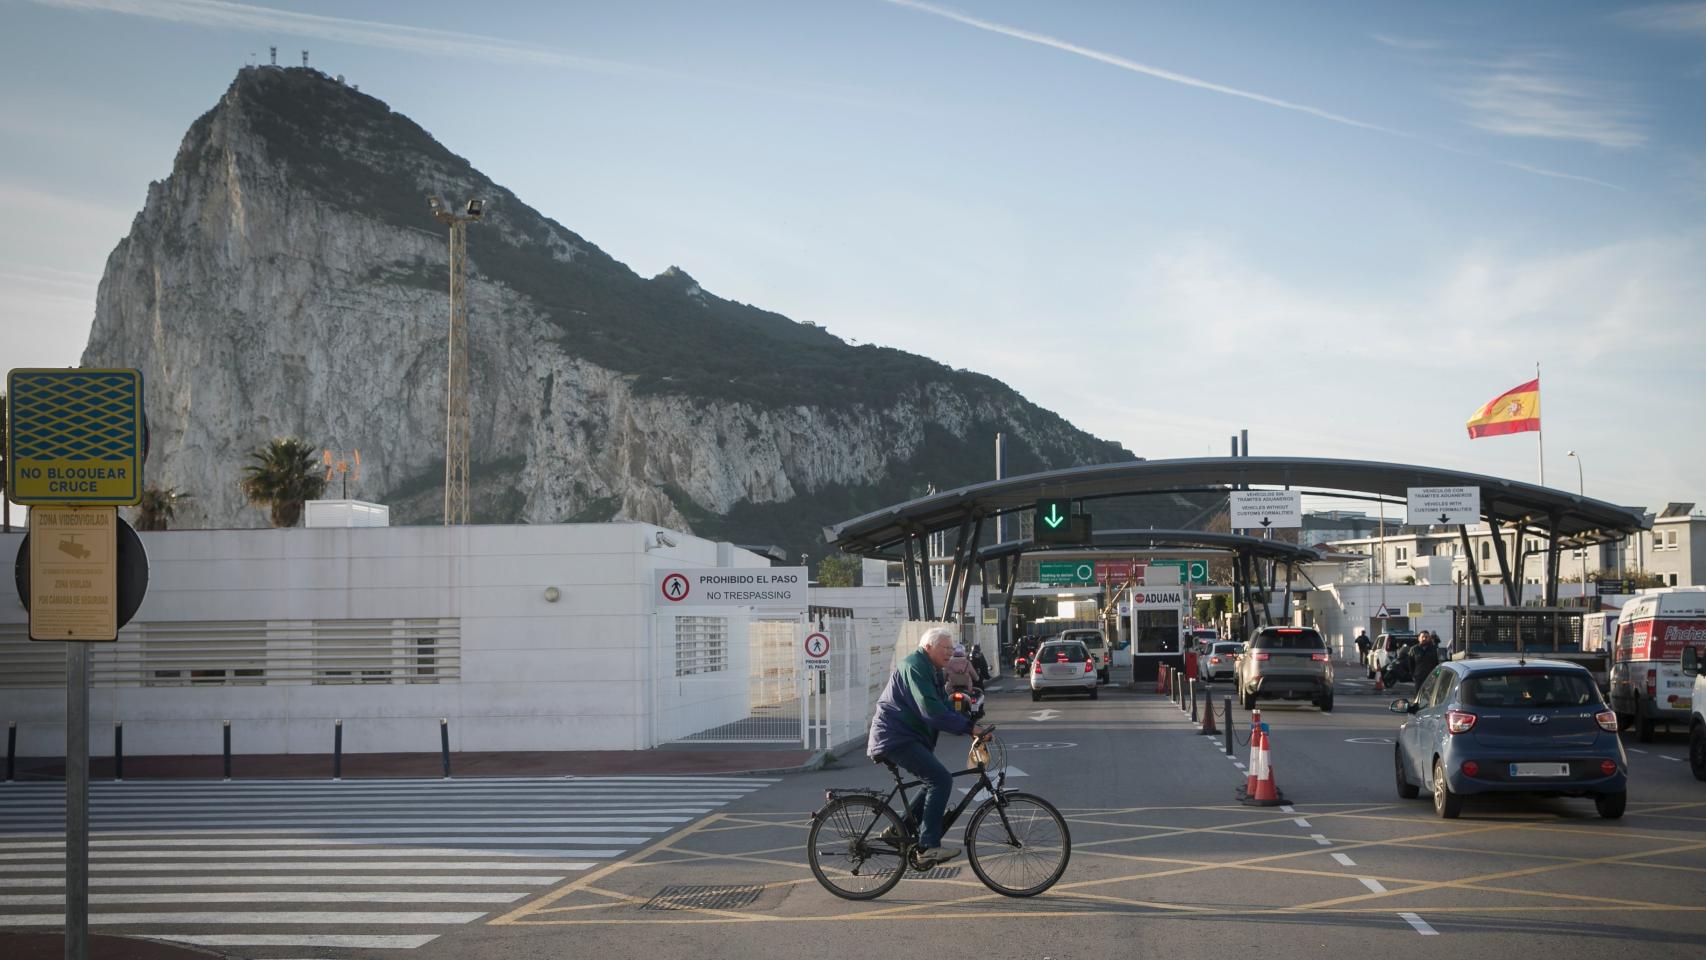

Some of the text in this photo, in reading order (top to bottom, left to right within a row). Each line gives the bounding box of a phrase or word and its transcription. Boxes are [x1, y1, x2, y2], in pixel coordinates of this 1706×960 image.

[21, 468, 126, 479] NO BLOQUEAR
[49, 481, 97, 492] CRUCE
[39, 514, 109, 526] ZONA VIDEOVIGILADA
[699, 575, 798, 584] PROHIBIDO EL PASO
[707, 590, 791, 600] NO TRESPASSING
[1145, 593, 1181, 604] ADUANA
